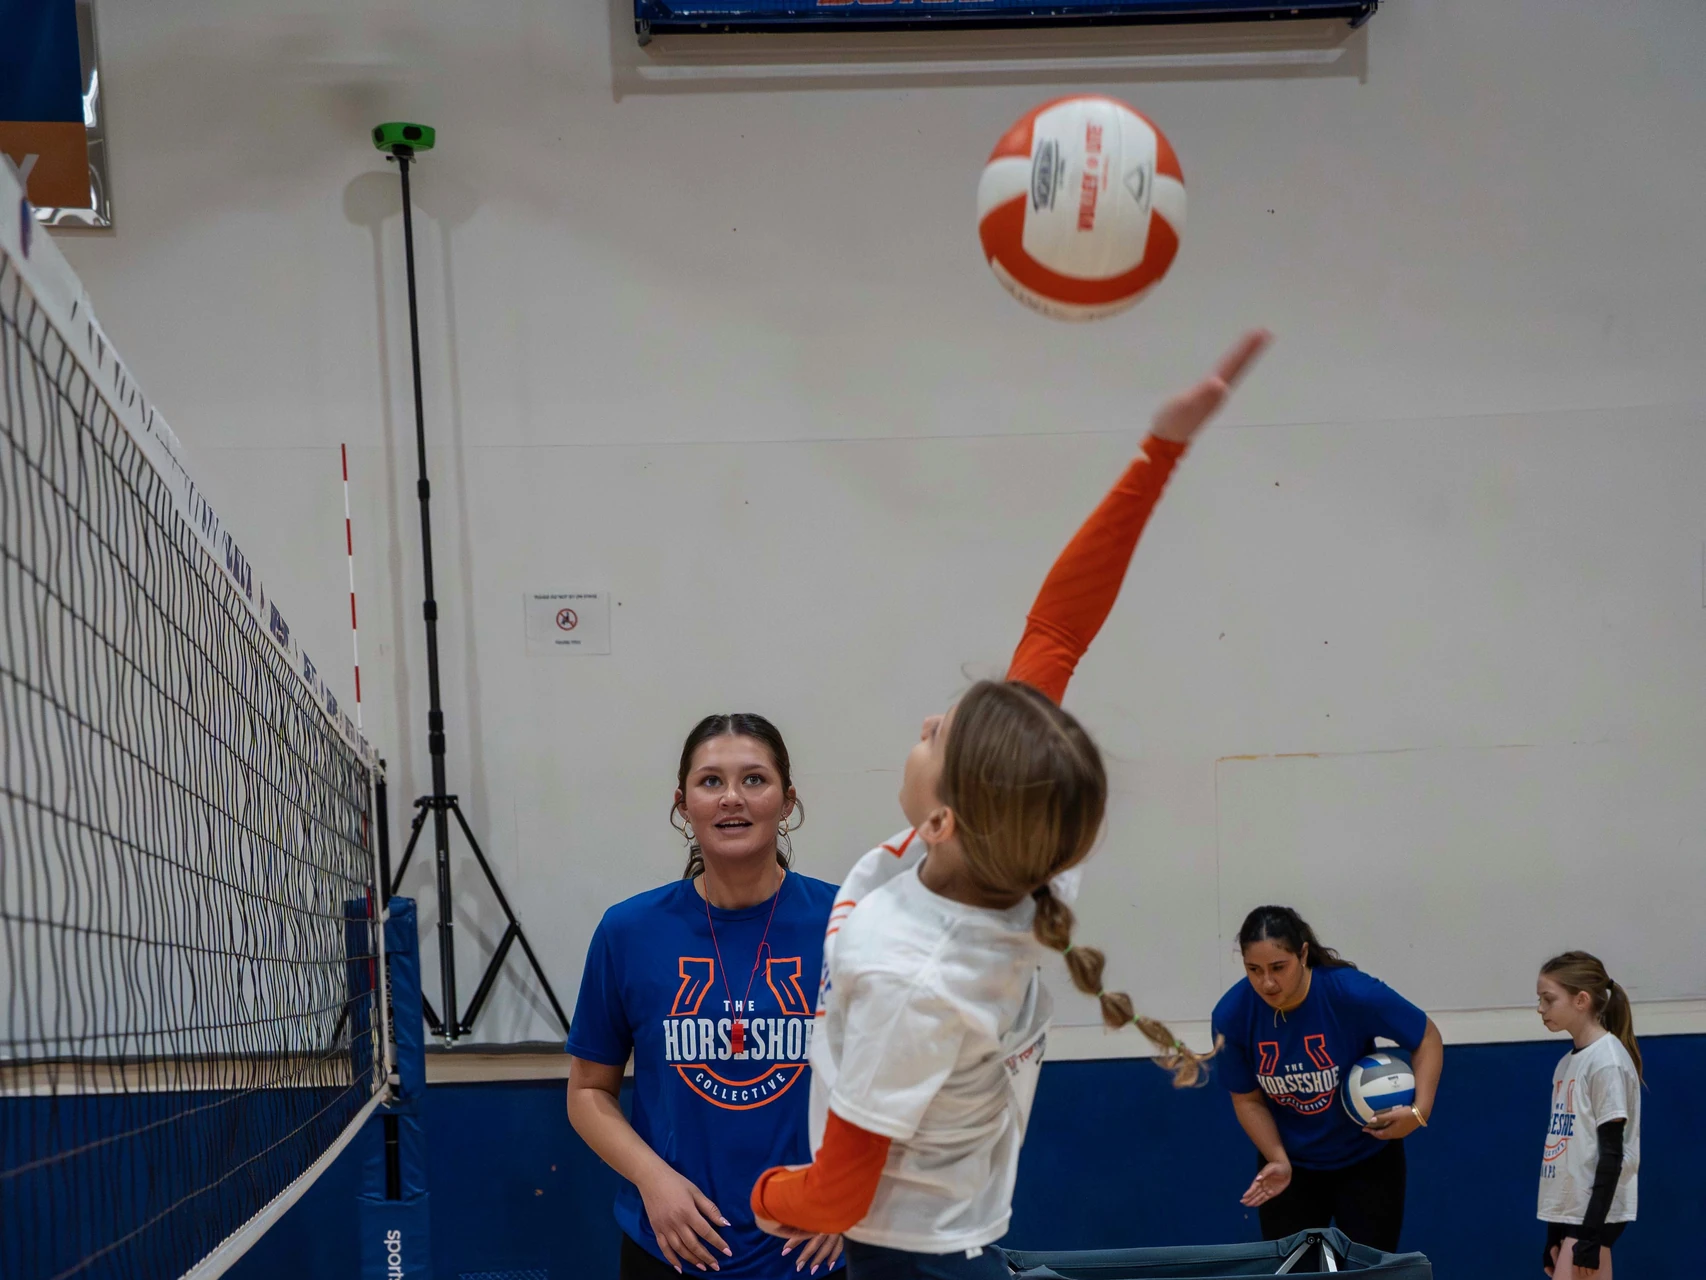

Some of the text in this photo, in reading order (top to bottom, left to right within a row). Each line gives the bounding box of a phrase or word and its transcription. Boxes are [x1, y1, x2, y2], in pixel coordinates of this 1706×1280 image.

[723, 1000, 755, 1012] THE
[1285, 1063, 1304, 1072] THE
[695, 1072, 786, 1101] COLLECTIVE
[1256, 1065, 1340, 1095] HORSESHOE
